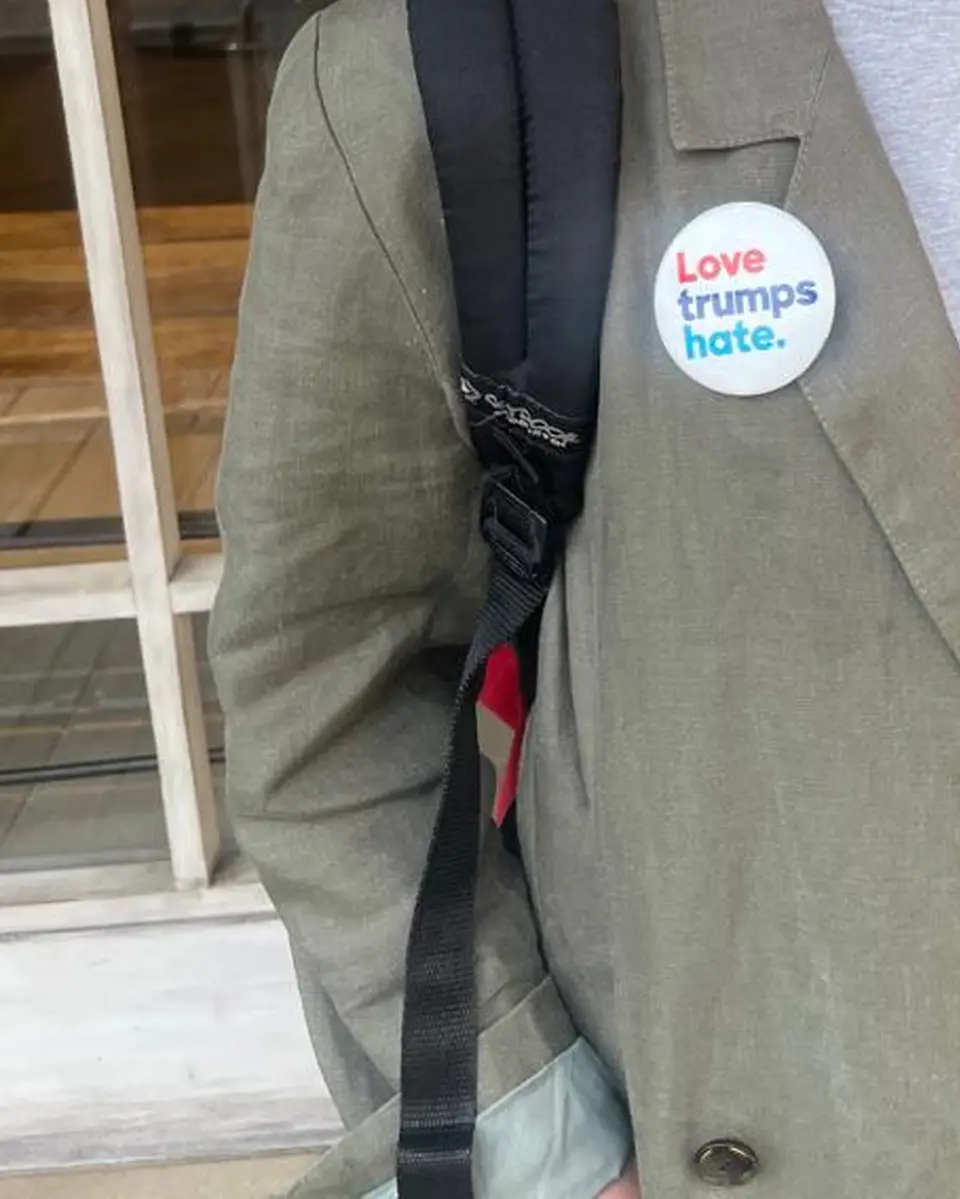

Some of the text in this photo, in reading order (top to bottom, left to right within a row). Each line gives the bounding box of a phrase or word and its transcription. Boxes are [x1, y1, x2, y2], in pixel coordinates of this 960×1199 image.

[676, 249, 766, 284] Love
[677, 280, 819, 321] trumps
[683, 320, 787, 360] hate.
